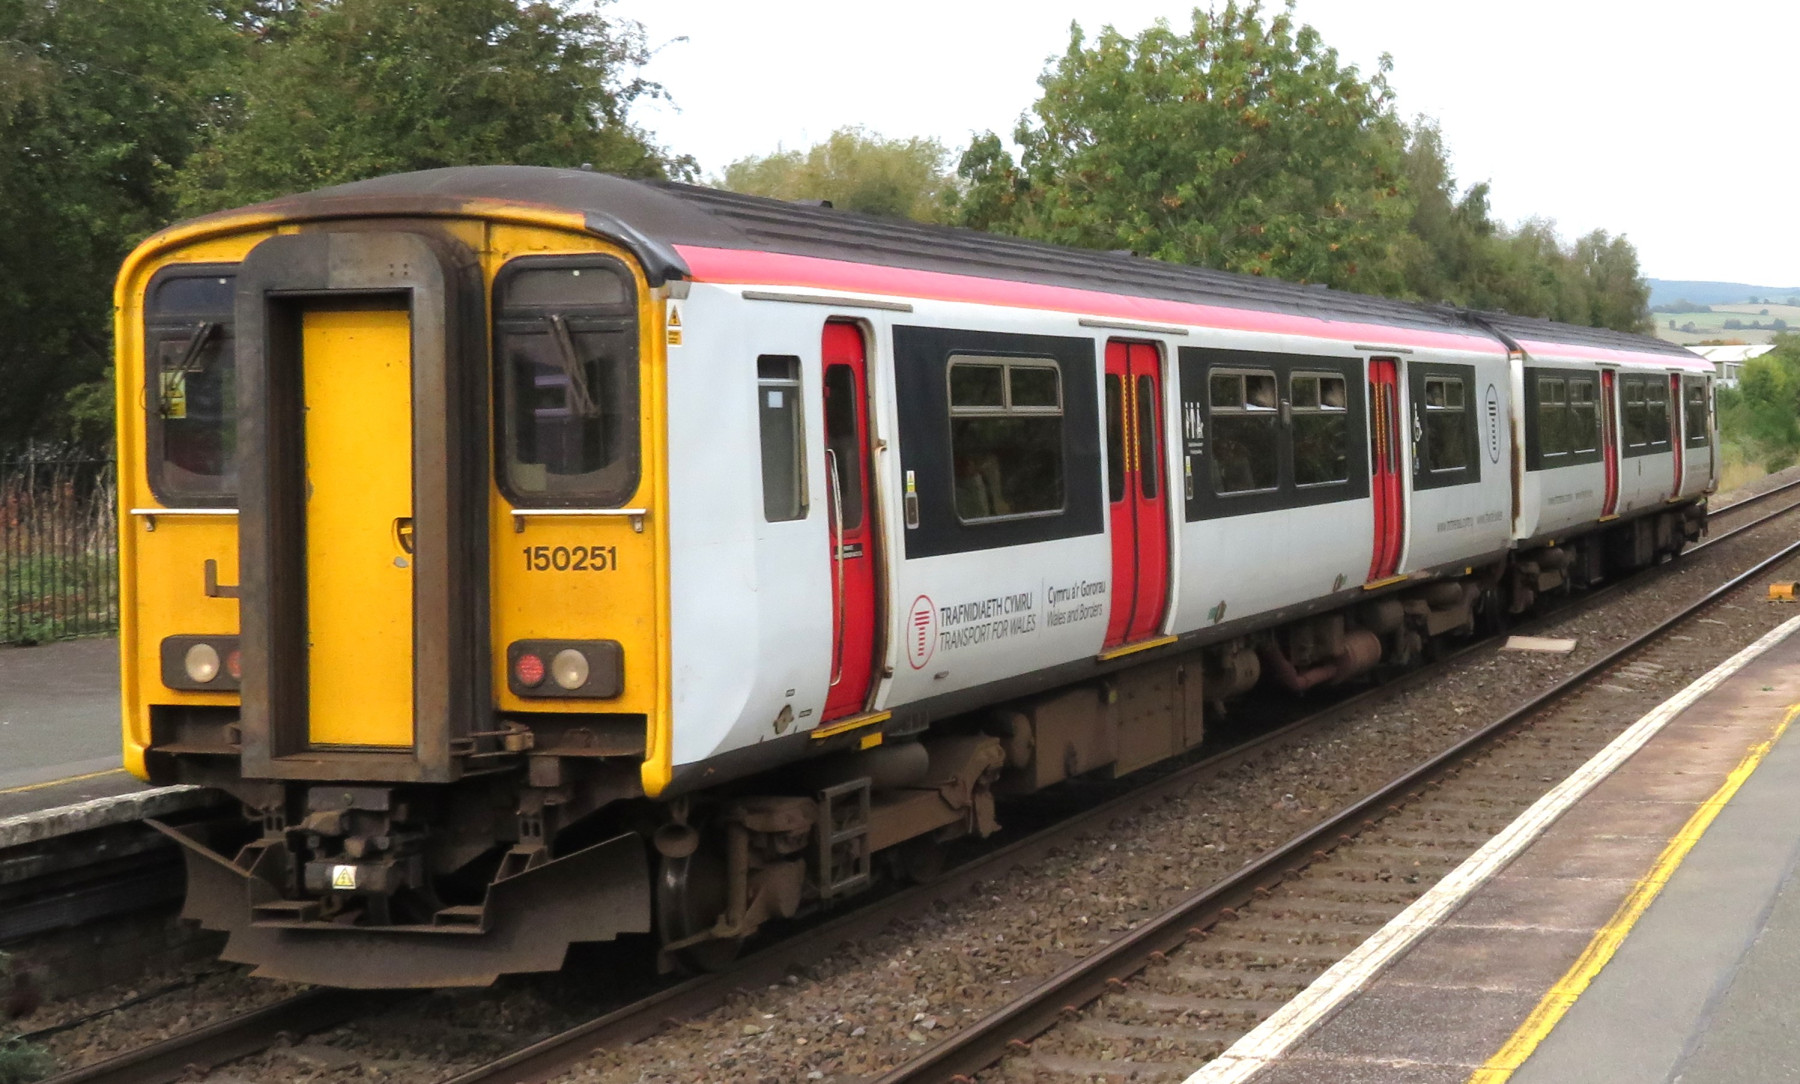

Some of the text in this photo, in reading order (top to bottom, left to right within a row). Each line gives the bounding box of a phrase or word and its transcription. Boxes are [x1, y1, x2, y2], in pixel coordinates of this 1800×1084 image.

[523, 546, 617, 571] 150251
[1048, 586, 1070, 608] Cymru
[1080, 580, 1106, 597] Gororau
[940, 592, 1032, 627] TRAFNIDIAETH CYMRU
[1046, 602, 1103, 628] Wales and Borders
[939, 613, 1036, 652] TRANSPORT FOR WALES
